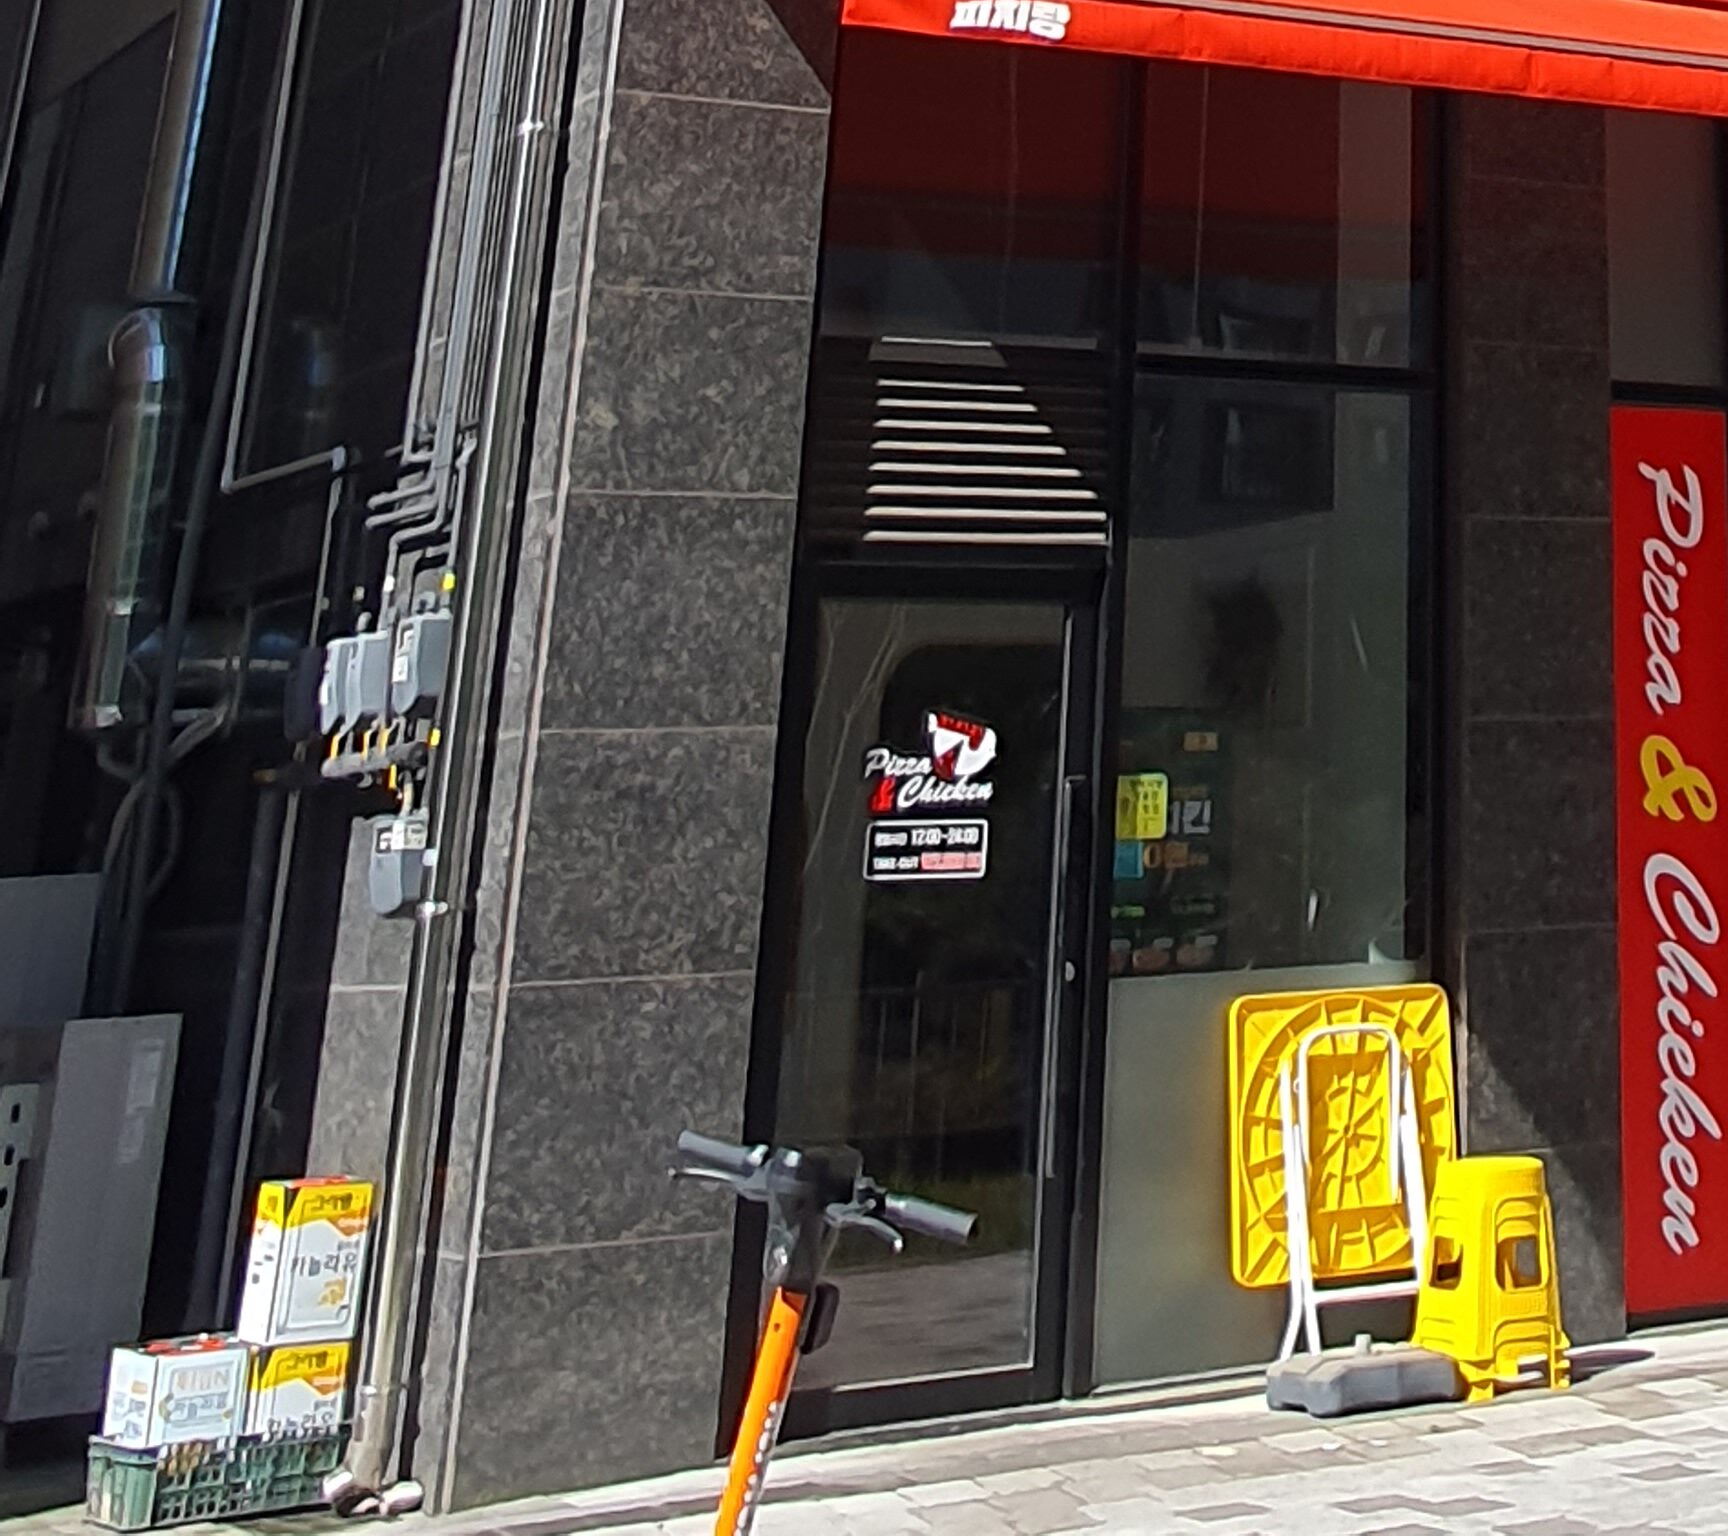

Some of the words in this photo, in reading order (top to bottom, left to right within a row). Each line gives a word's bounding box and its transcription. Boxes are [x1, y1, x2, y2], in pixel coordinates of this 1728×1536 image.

[1637, 460, 1705, 716] Pizza
[865, 748, 932, 778] Pizza
[897, 776, 994, 808] Chicken
[1639, 734, 1718, 823] &
[1643, 851, 1722, 1256] Chicken
